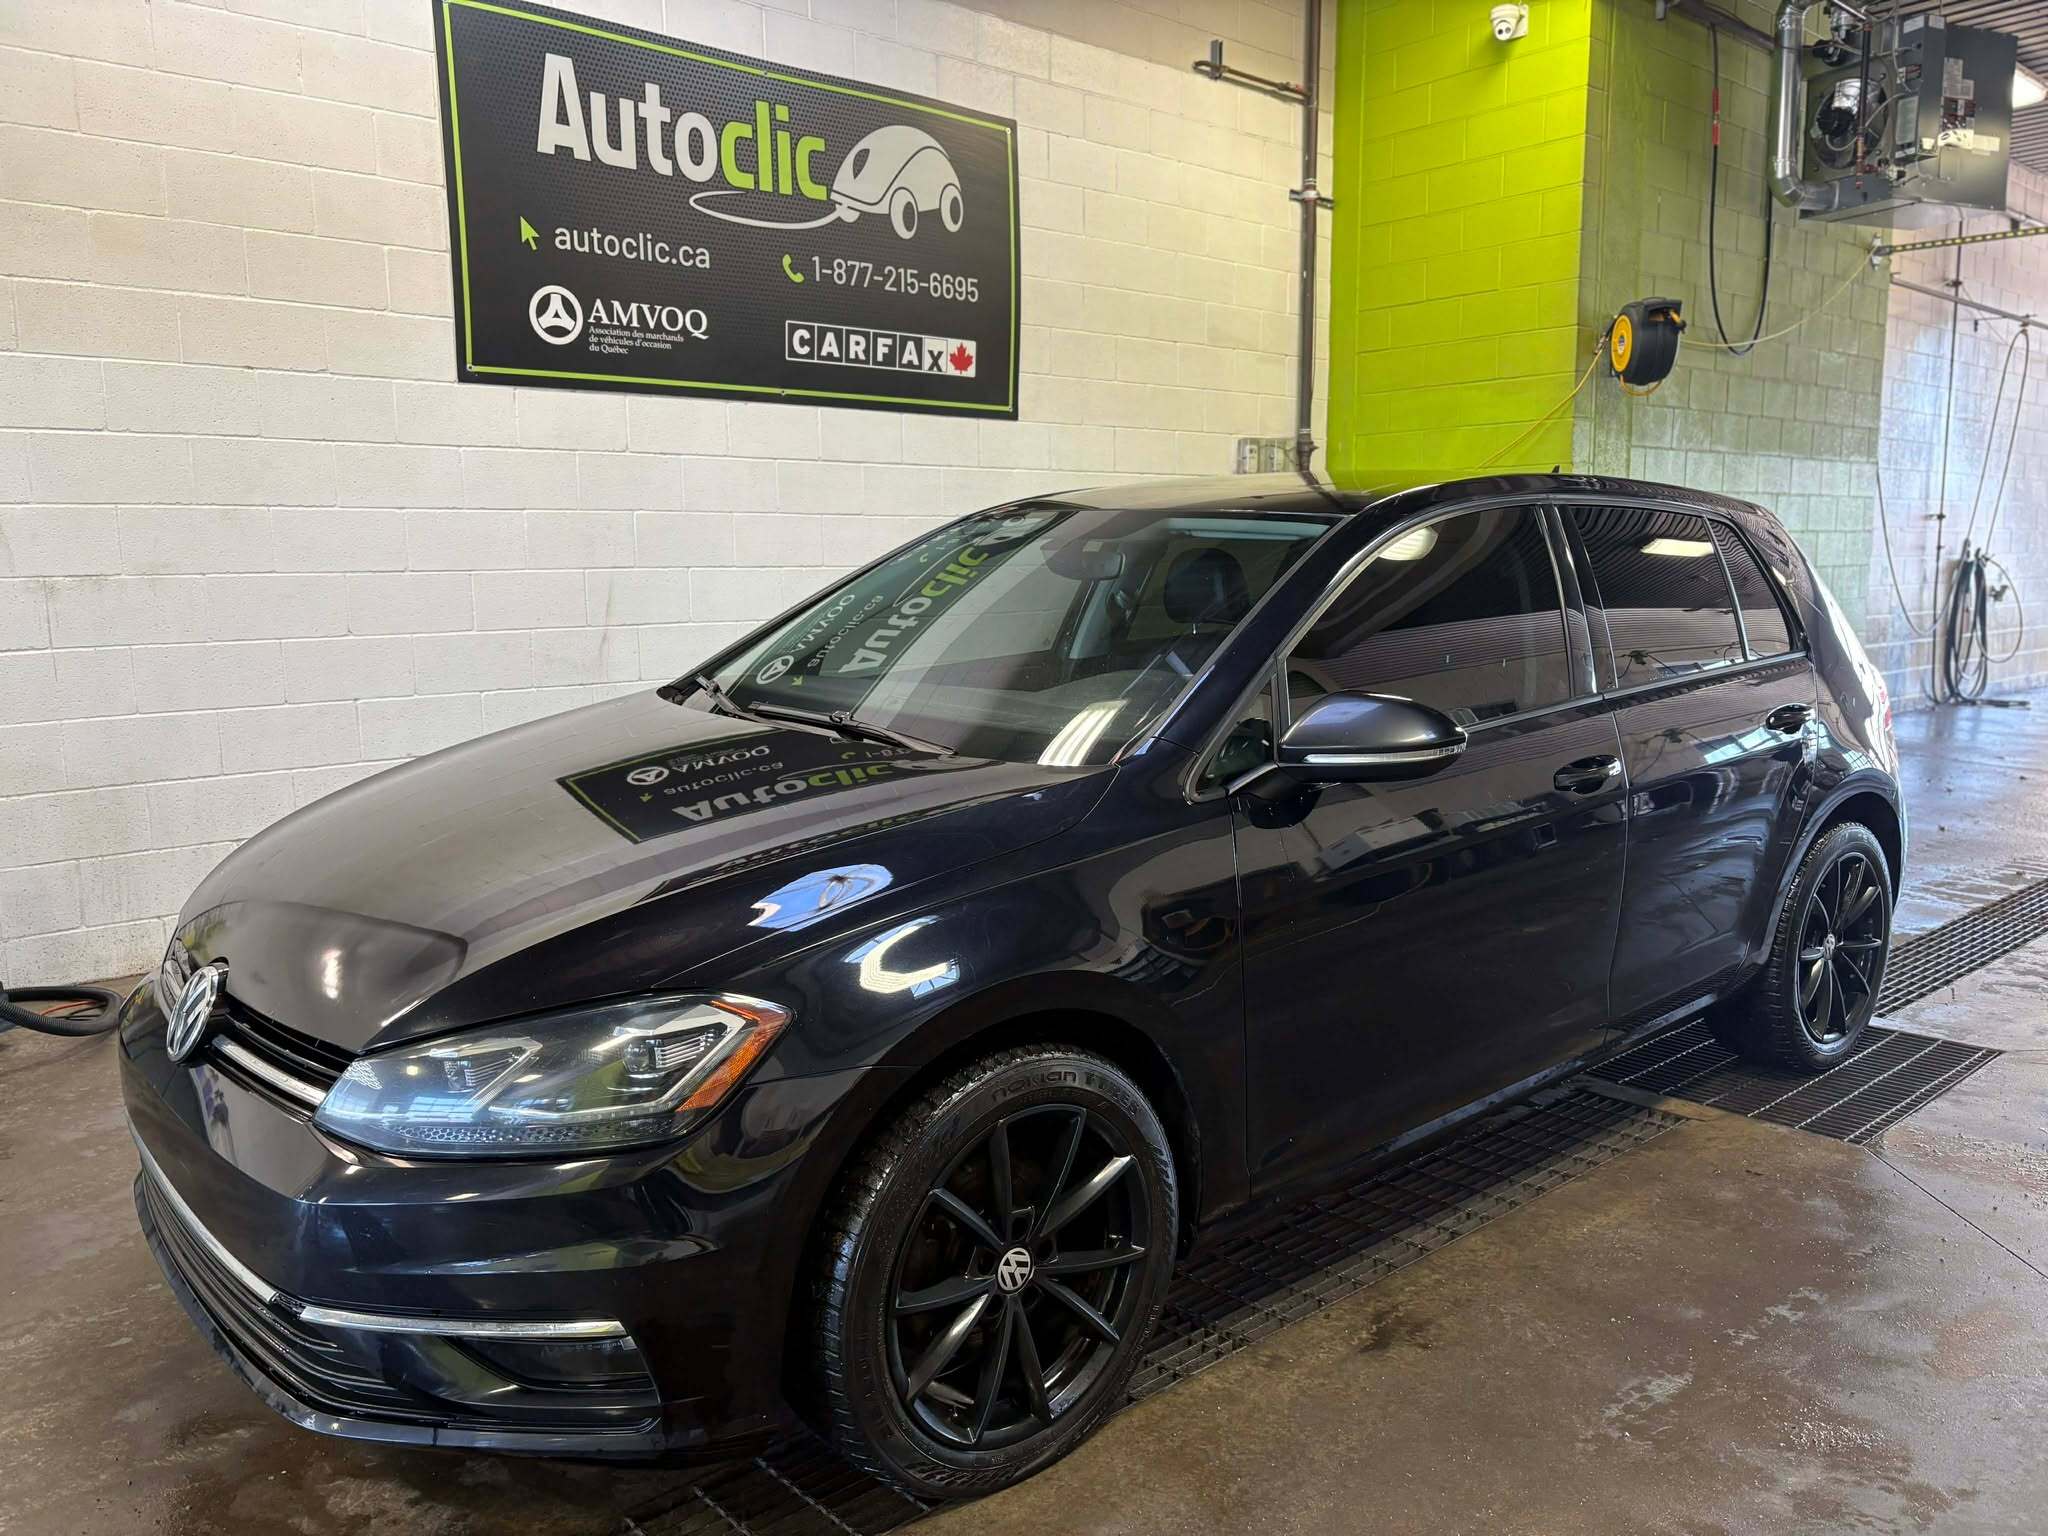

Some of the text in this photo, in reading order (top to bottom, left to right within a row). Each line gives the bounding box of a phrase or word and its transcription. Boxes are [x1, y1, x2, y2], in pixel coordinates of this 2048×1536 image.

[537, 53, 828, 200] Autoclic
[554, 227, 711, 269] autoclic.ca
[812, 256, 979, 303] 1-877-215-6695
[587, 298, 710, 340] AMVOQ
[588, 326, 685, 343] Association des marchands
[588, 335, 599, 343] de
[600, 335, 634, 347] véhicules
[589, 343, 629, 355] du Québec
[792, 328, 944, 373] CARFAX
